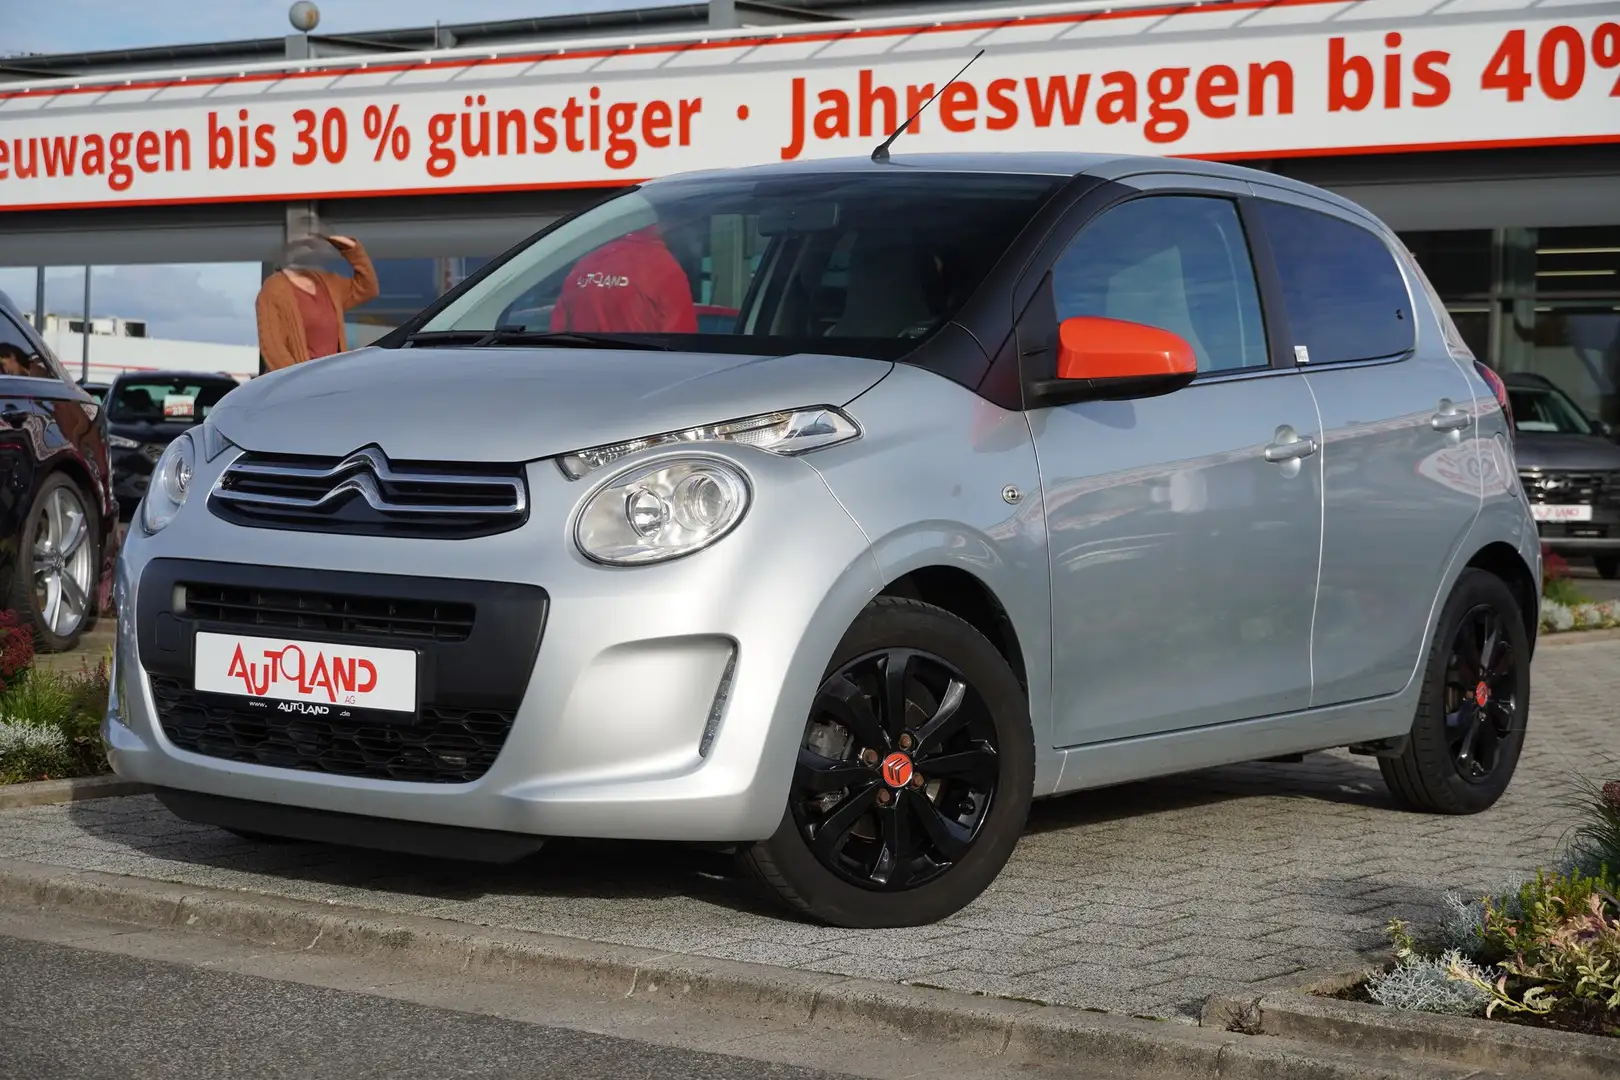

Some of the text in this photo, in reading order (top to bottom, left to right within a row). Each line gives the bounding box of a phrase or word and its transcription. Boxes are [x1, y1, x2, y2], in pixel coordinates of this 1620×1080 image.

[208, 109, 275, 169] bis
[293, 108, 347, 165] 30
[364, 105, 410, 162] %
[426, 87, 703, 178] günstiger
[780, 60, 1294, 160] Jahreswagen
[1328, 32, 1452, 112] bis
[227, 642, 378, 703] AUTOLAND
[277, 702, 329, 716] AUTOLAND
[339, 710, 351, 718] .de
[345, 696, 356, 705] AG
